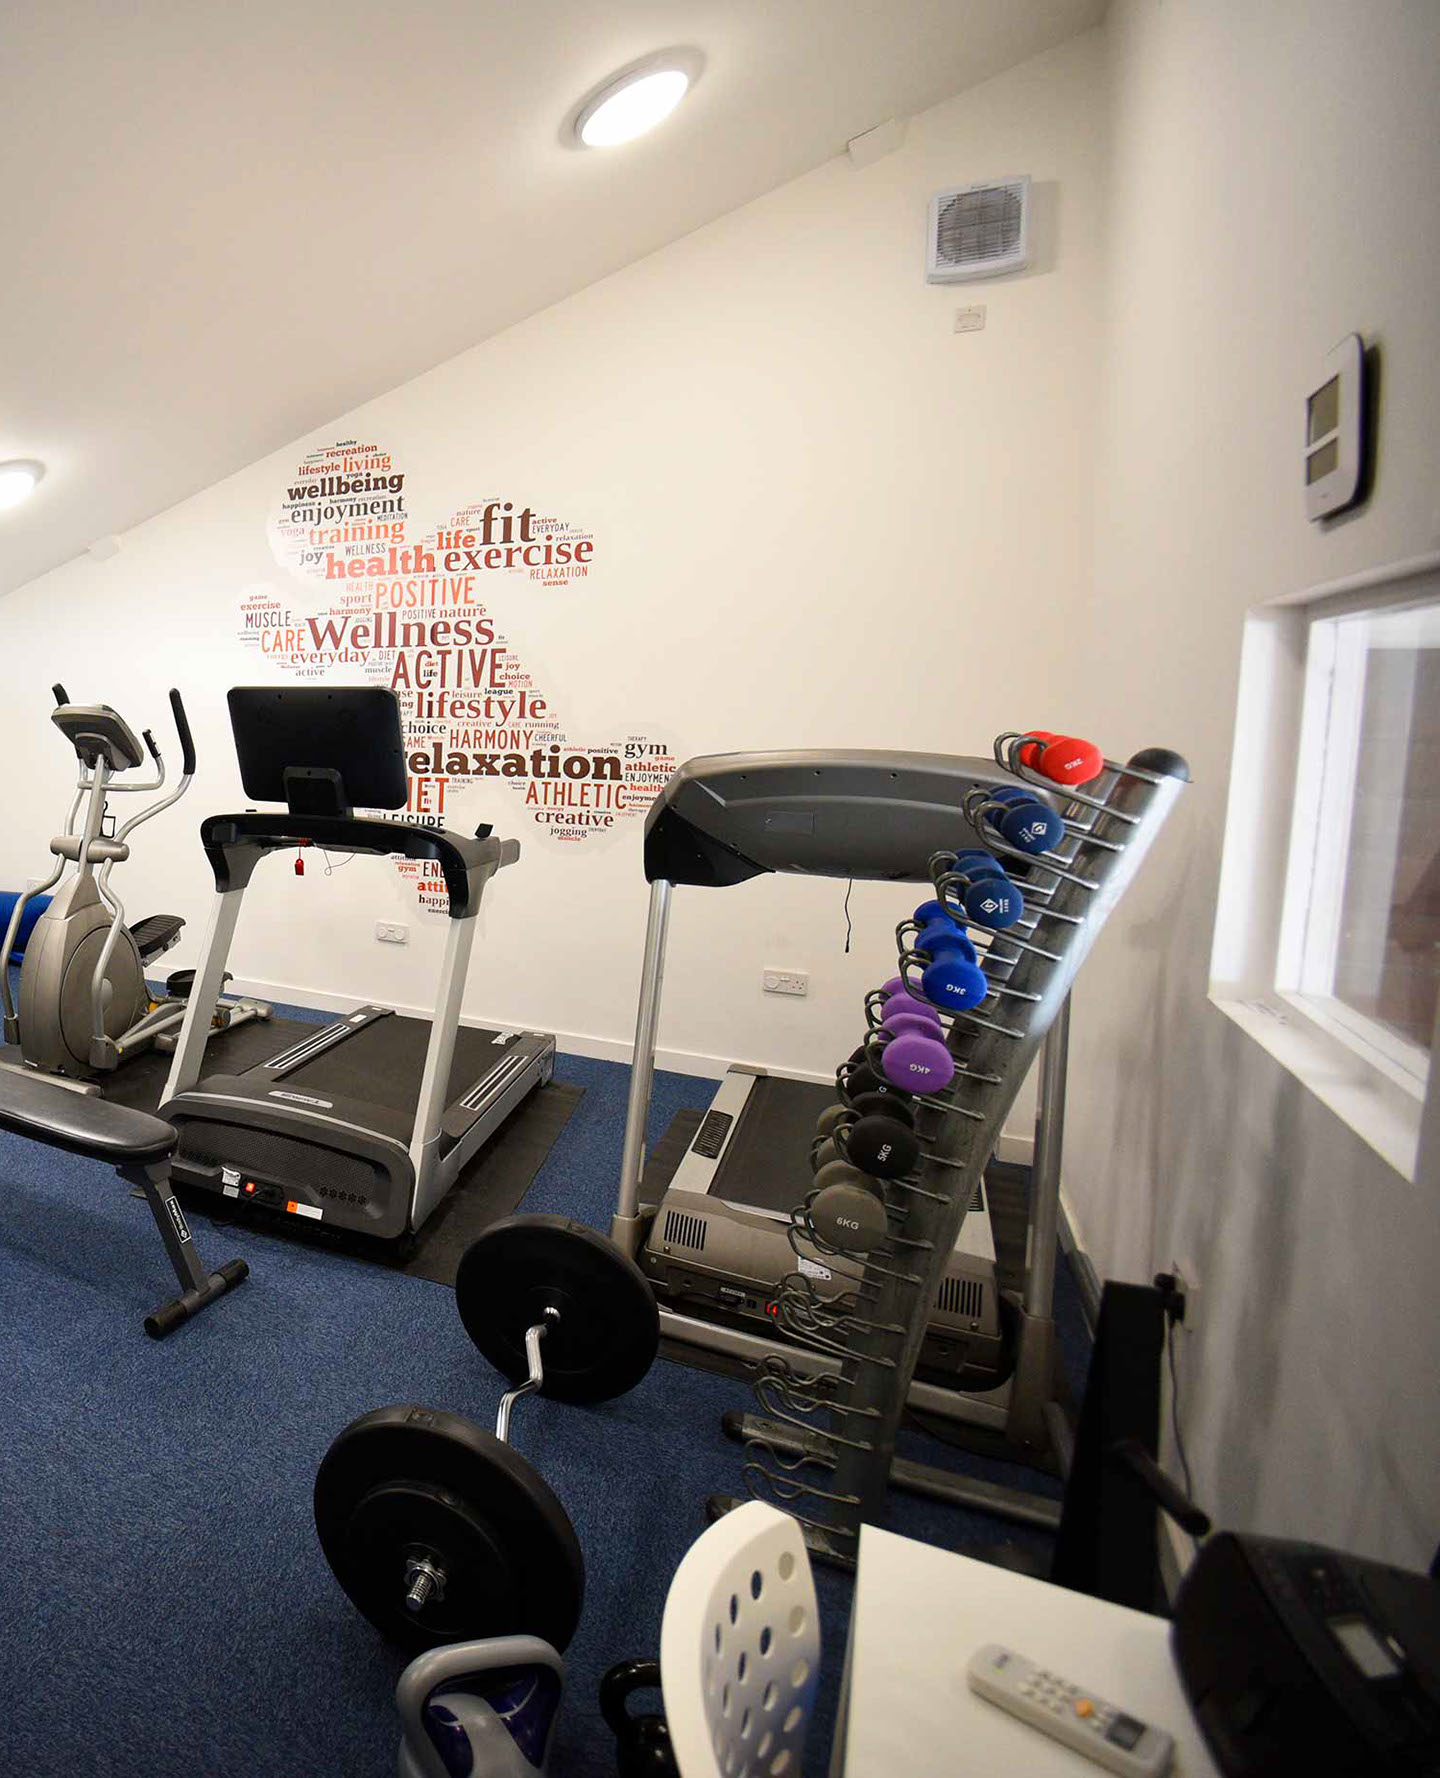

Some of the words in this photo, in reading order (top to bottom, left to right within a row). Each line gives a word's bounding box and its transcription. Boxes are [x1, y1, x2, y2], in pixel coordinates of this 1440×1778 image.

[326, 444, 378, 458] recreation
[298, 462, 341, 476] lifestyle
[343, 454, 391, 472] living
[287, 472, 405, 501] wellbeing
[282, 501, 316, 510] happiness
[291, 496, 405, 526] enjoyment
[450, 516, 471, 527] CARE
[480, 502, 536, 546] fit
[531, 517, 557, 525] active
[310, 518, 405, 545] training
[532, 522, 570, 534] EVERYDAY
[437, 529, 476, 551] life
[555, 533, 594, 542] relaxation
[345, 543, 386, 556] WELLNESS
[444, 534, 594, 572] exercise
[299, 549, 323, 566] joy
[326, 545, 436, 579] health
[529, 566, 588, 580] RELAXATION
[375, 576, 475, 609] POSITIVE
[240, 601, 281, 611] exercise
[340, 593, 372, 607] sport
[329, 606, 371, 616] harmony
[402, 608, 436, 620] POSITIVE
[439, 606, 487, 619] nature
[245, 611, 291, 628] MUSCLE
[305, 612, 495, 651] Wellness
[261, 629, 306, 653] CARE
[291, 647, 370, 668] everyday
[378, 650, 396, 661] DIET
[295, 667, 325, 677] active
[365, 666, 392, 674] muscle
[390, 648, 507, 689] ACTIVE
[505, 662, 520, 671] joy
[423, 669, 438, 678] life
[499, 673, 530, 681] choice
[451, 690, 482, 699] leisure
[484, 689, 514, 698] league
[415, 690, 546, 727] lifestyle
[402, 721, 447, 734] choice
[457, 719, 492, 728] creative
[525, 721, 559, 730] running
[449, 729, 534, 750] HARMONY
[534, 733, 567, 743] CHEERFUL
[624, 742, 668, 759] gym
[405, 742, 623, 780] elaxation
[625, 762, 677, 773] athletic
[630, 783, 665, 793] health
[406, 777, 449, 813] IET
[526, 781, 628, 809] ATHLETIC
[622, 794, 658, 802] enjoyme
[534, 810, 614, 827] creative
[550, 825, 588, 838] jogging
[398, 864, 417, 873] gym
[417, 881, 448, 892] atti
[418, 894, 449, 907] happi
[946, 984, 966, 996] 3KG
[910, 1063, 931, 1075] 4KG
[877, 1144, 892, 1162] 5KG
[836, 1216, 860, 1230] 6KG
